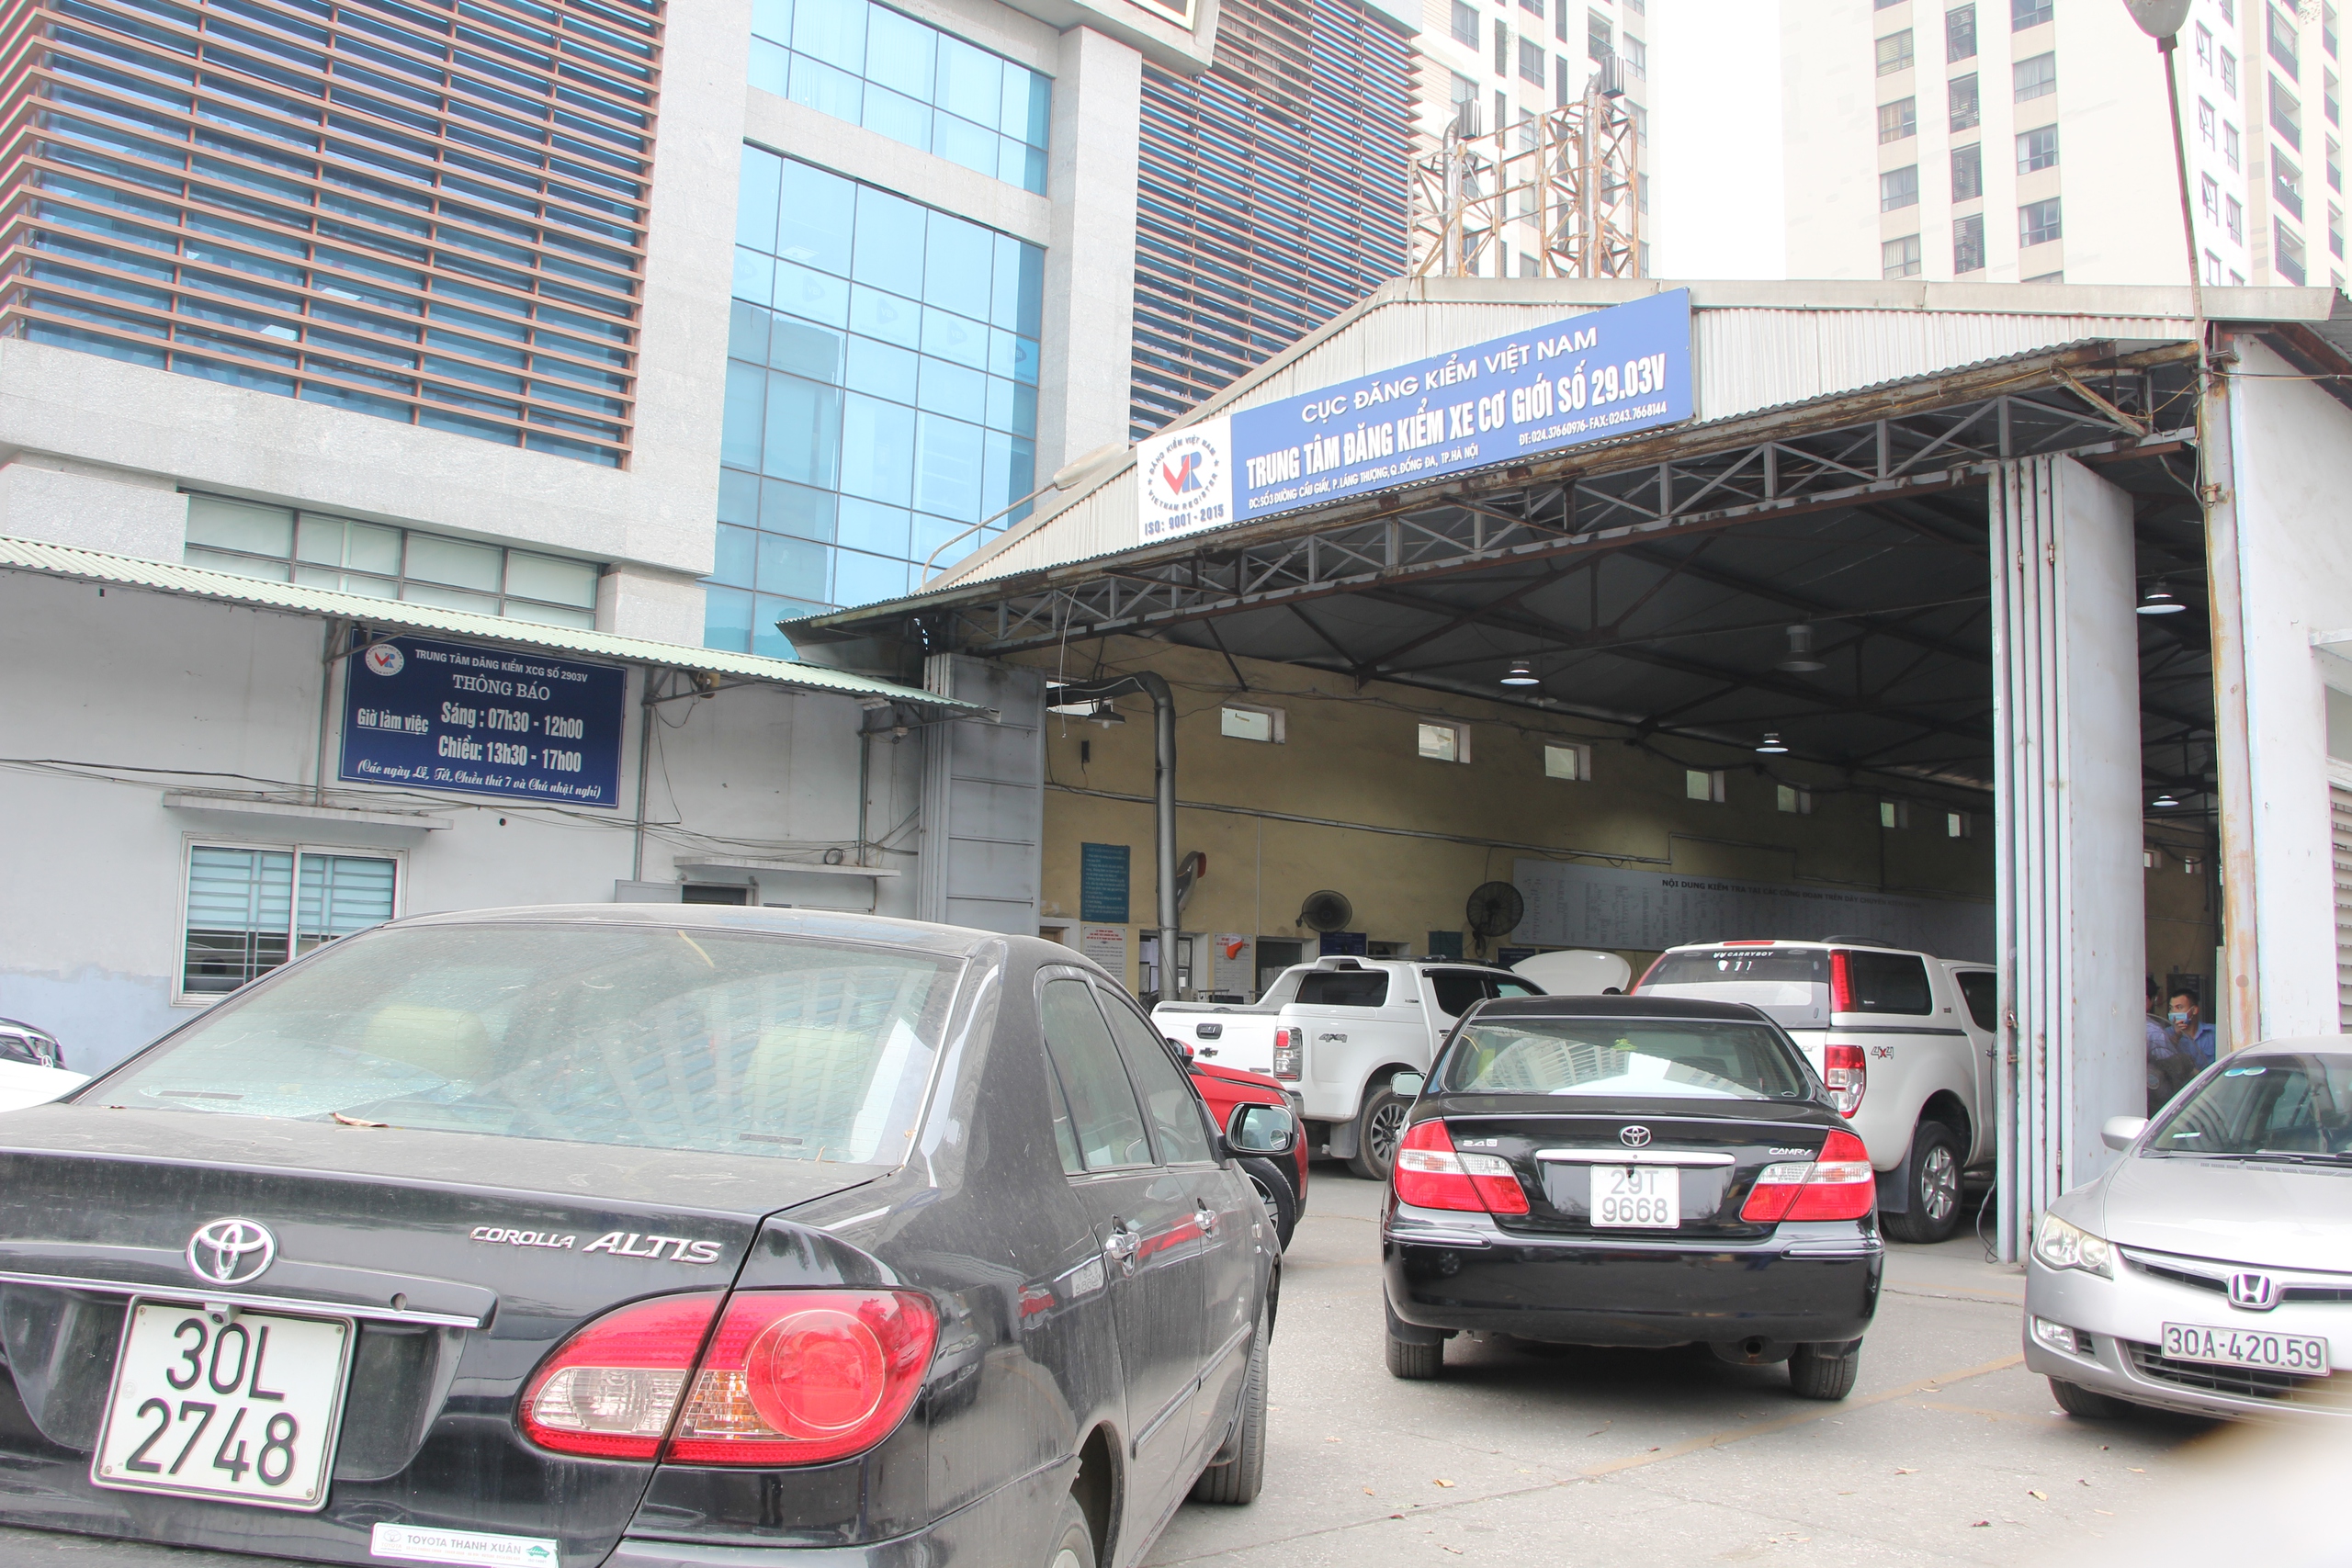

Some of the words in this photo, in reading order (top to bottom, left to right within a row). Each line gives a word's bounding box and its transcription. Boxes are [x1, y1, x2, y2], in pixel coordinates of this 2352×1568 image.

[1301, 395, 1348, 424] CỤC
[1353, 376, 1419, 411] ĐĂNG
[1425, 353, 1478, 391] KIỂM
[1485, 343, 1532, 375] VIỆT
[1537, 326, 1597, 362] NAM
[1246, 446, 1301, 491] TRUNG
[1303, 434, 1340, 477] TÂM
[1343, 422, 1394, 467] ĐĂNG
[1397, 398, 1445, 453] KIỂM
[1449, 401, 1475, 441] XE
[1478, 389, 1507, 433] CƠ
[1511, 372, 1555, 425] GIỚI
[1557, 359, 1588, 413] SỐ
[1591, 353, 1668, 407] 29.03V
[1166, 436, 1182, 453] KIỂM
[1185, 434, 1200, 446] VIỆT
[1202, 439, 1216, 457] NAM
[1148, 489, 1180, 512] VIETNAM
[1182, 472, 1218, 510] REGISTER
[1273, 489, 1298, 505] ĐƯỜNG
[1464, 444, 1479, 461] NỘI
[1144, 520, 1165, 536] ISO:
[1169, 512, 1192, 530] 9001
[1200, 503, 1225, 522] 2015
[414, 649, 447, 663] TRUNG
[449, 653, 470, 666] TÂM
[471, 656, 500, 670] ĐĂNG
[501, 659, 524, 673] KIỂM
[526, 665, 545, 677] XCG
[547, 666, 560, 679] SỐ
[560, 671, 588, 682] 2903V
[452, 673, 513, 696] THÔNG
[515, 681, 551, 701] BÁO
[356, 707, 377, 727] Giờ
[379, 709, 401, 729] làm
[404, 714, 429, 734] việc
[440, 701, 477, 729] Sáng
[488, 707, 529, 733] 07h30
[544, 715, 583, 739] 12h00
[438, 734, 482, 761] Chiều:
[487, 741, 528, 767] 13h30
[542, 748, 582, 773] 17h00
[356, 759, 382, 775] (Các
[383, 765, 411, 779] ngày
[433, 766, 453, 783] Tết,
[484, 772, 503, 787] thứ
[504, 775, 512, 787] 7
[513, 777, 526, 790] và
[549, 780, 574, 796] nhật
[1662, 878, 1679, 888] NỘI
[1681, 880, 1706, 890] DUNG
[1730, 885, 1746, 893] TRA
[1769, 1147, 1814, 1156] CAMRY
[1611, 1169, 1659, 1195] 29T
[1602, 1197, 1668, 1224] 9668
[469, 1226, 577, 1250] COROLLA
[582, 1231, 723, 1265] ALTIS
[165, 1317, 286, 1403] 30L
[2167, 1326, 2323, 1370] 30A-420.59
[126, 1397, 299, 1486] 2748
[407, 1534, 447, 1548] TOYOTA
[450, 1539, 487, 1551] THANH
[490, 1542, 521, 1555] XUÂN
